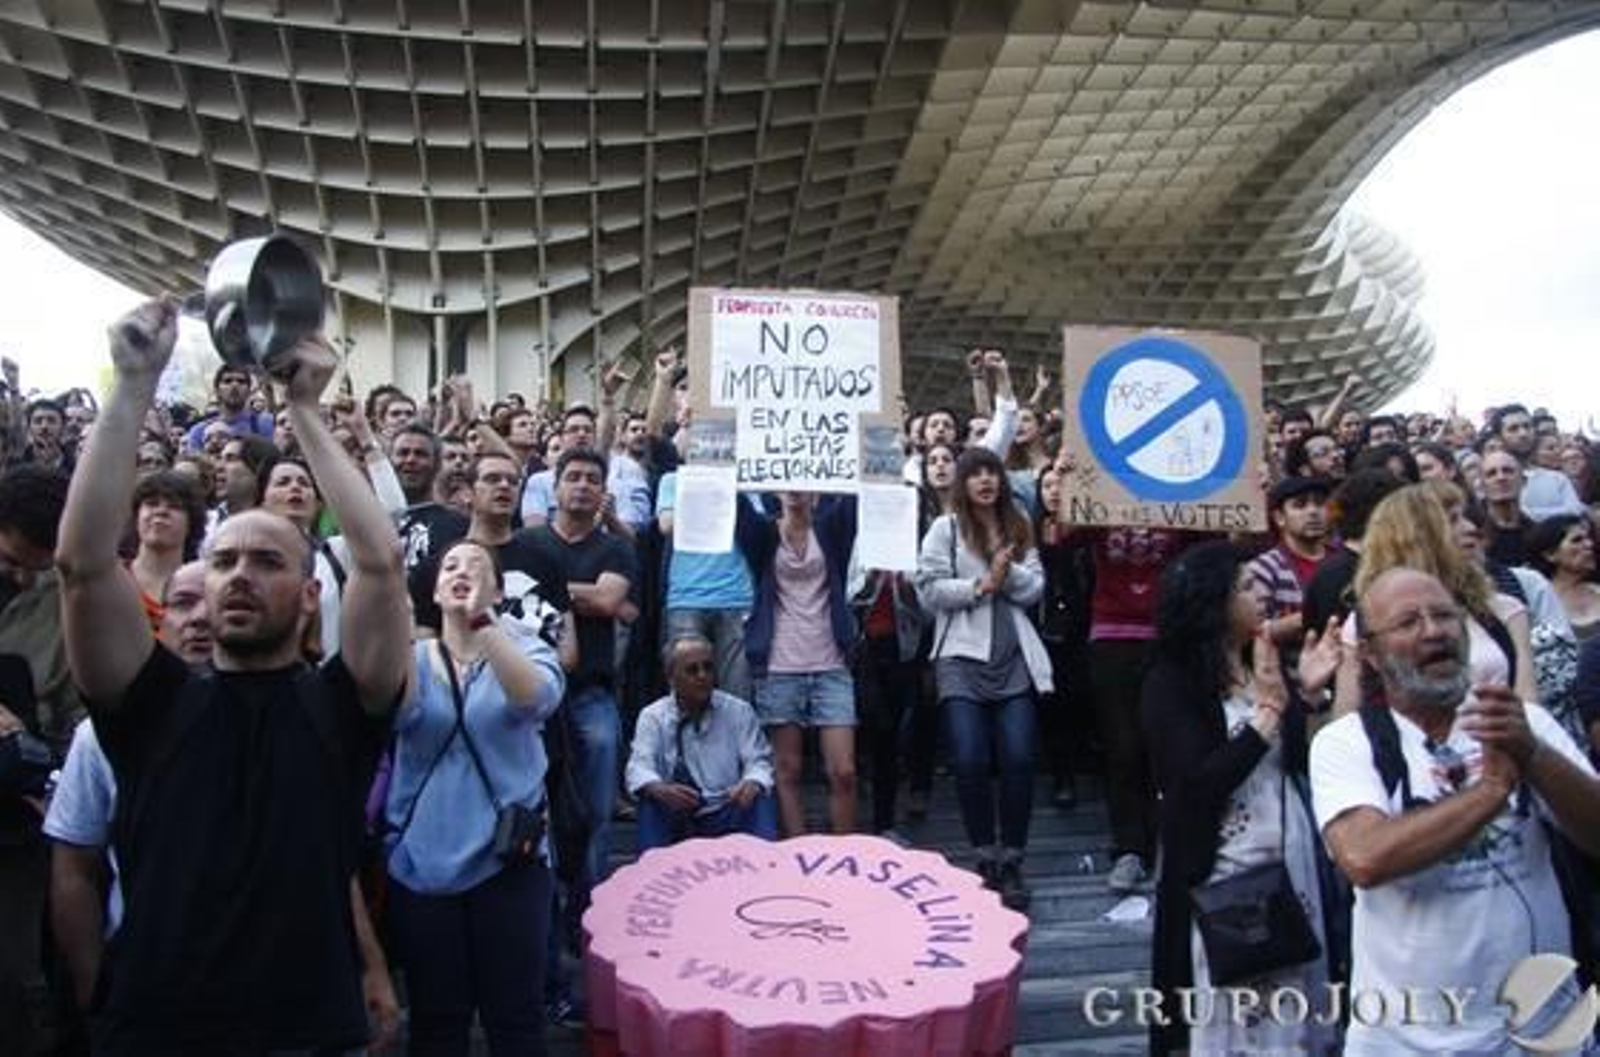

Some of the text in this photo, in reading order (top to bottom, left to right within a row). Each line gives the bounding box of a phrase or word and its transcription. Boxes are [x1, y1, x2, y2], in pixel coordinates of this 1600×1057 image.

[760, 320, 829, 356] NO
[752, 407, 849, 434] EN LAS
[736, 458, 857, 482] ELECTORALES
[1069, 497, 1108, 523] NO
[1160, 503, 1250, 528] VOTES
[678, 957, 888, 1003] NEUTRA
